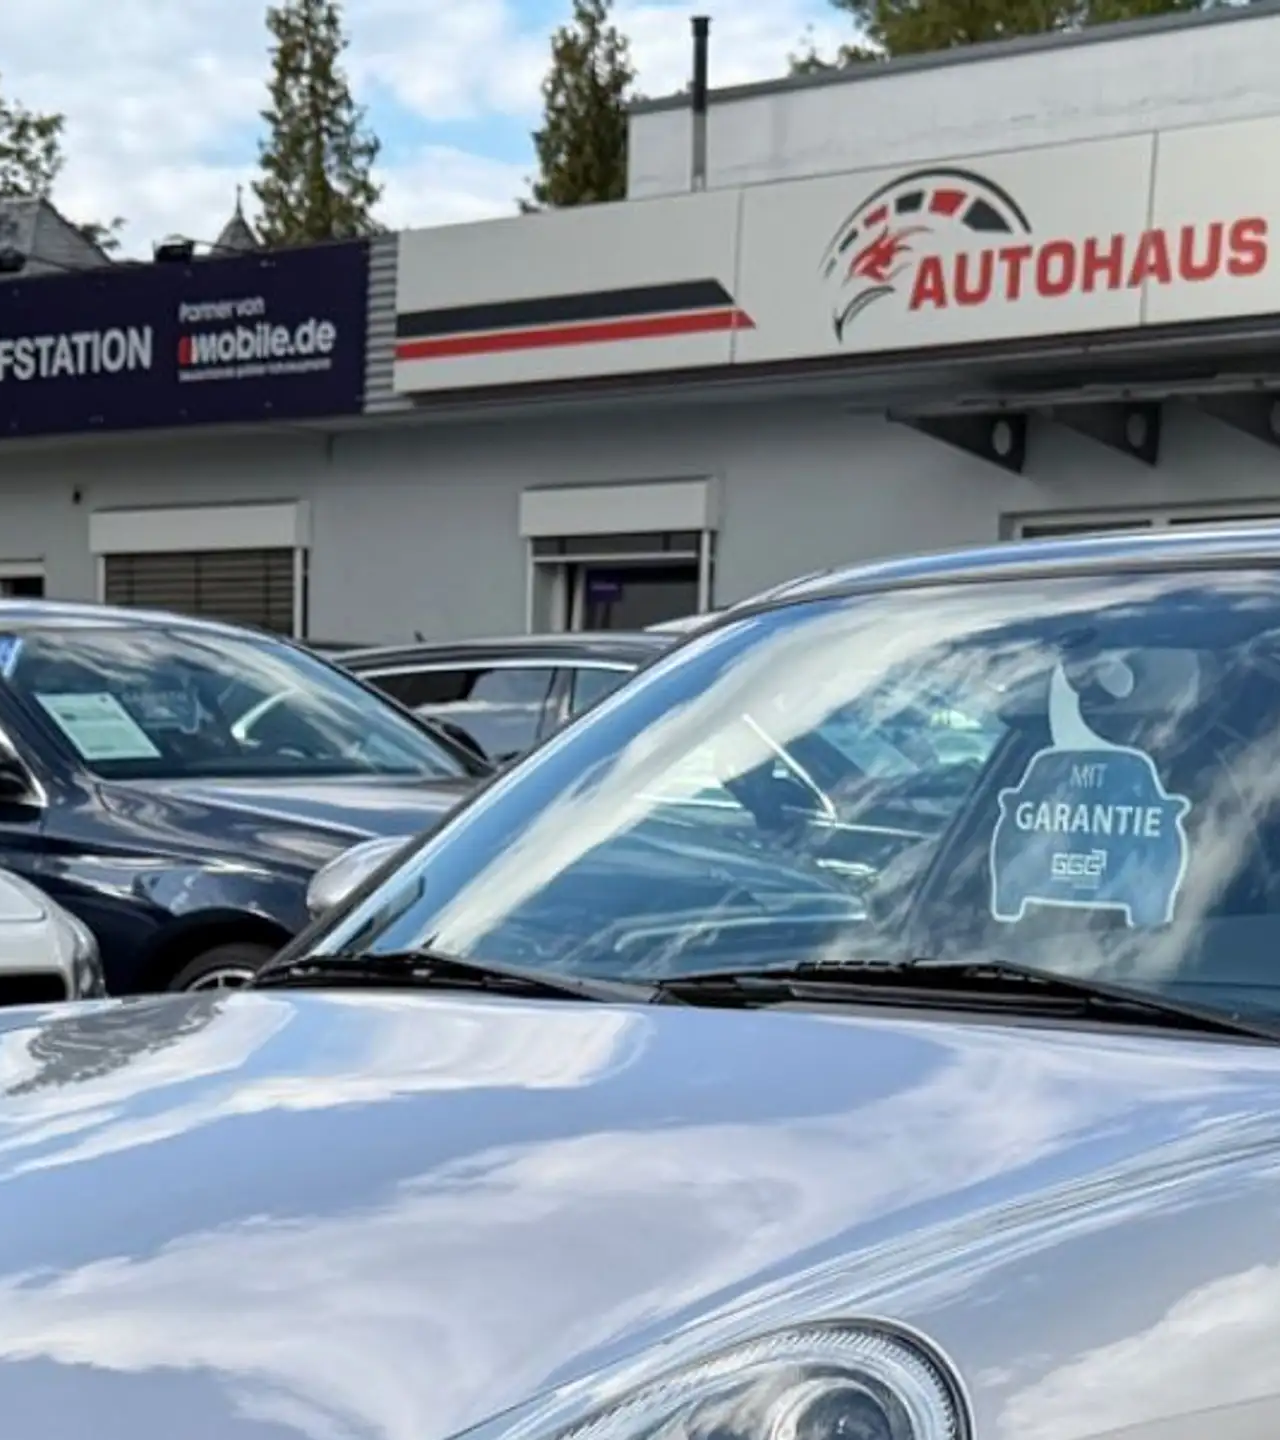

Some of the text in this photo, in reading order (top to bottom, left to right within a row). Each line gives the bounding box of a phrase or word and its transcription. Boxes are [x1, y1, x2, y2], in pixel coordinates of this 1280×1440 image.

[908, 216, 1269, 312] AUTOHAUS
[179, 318, 335, 366] mobile.de
[1070, 763, 1108, 789] MIT
[1015, 801, 1163, 838] GARANTIE
